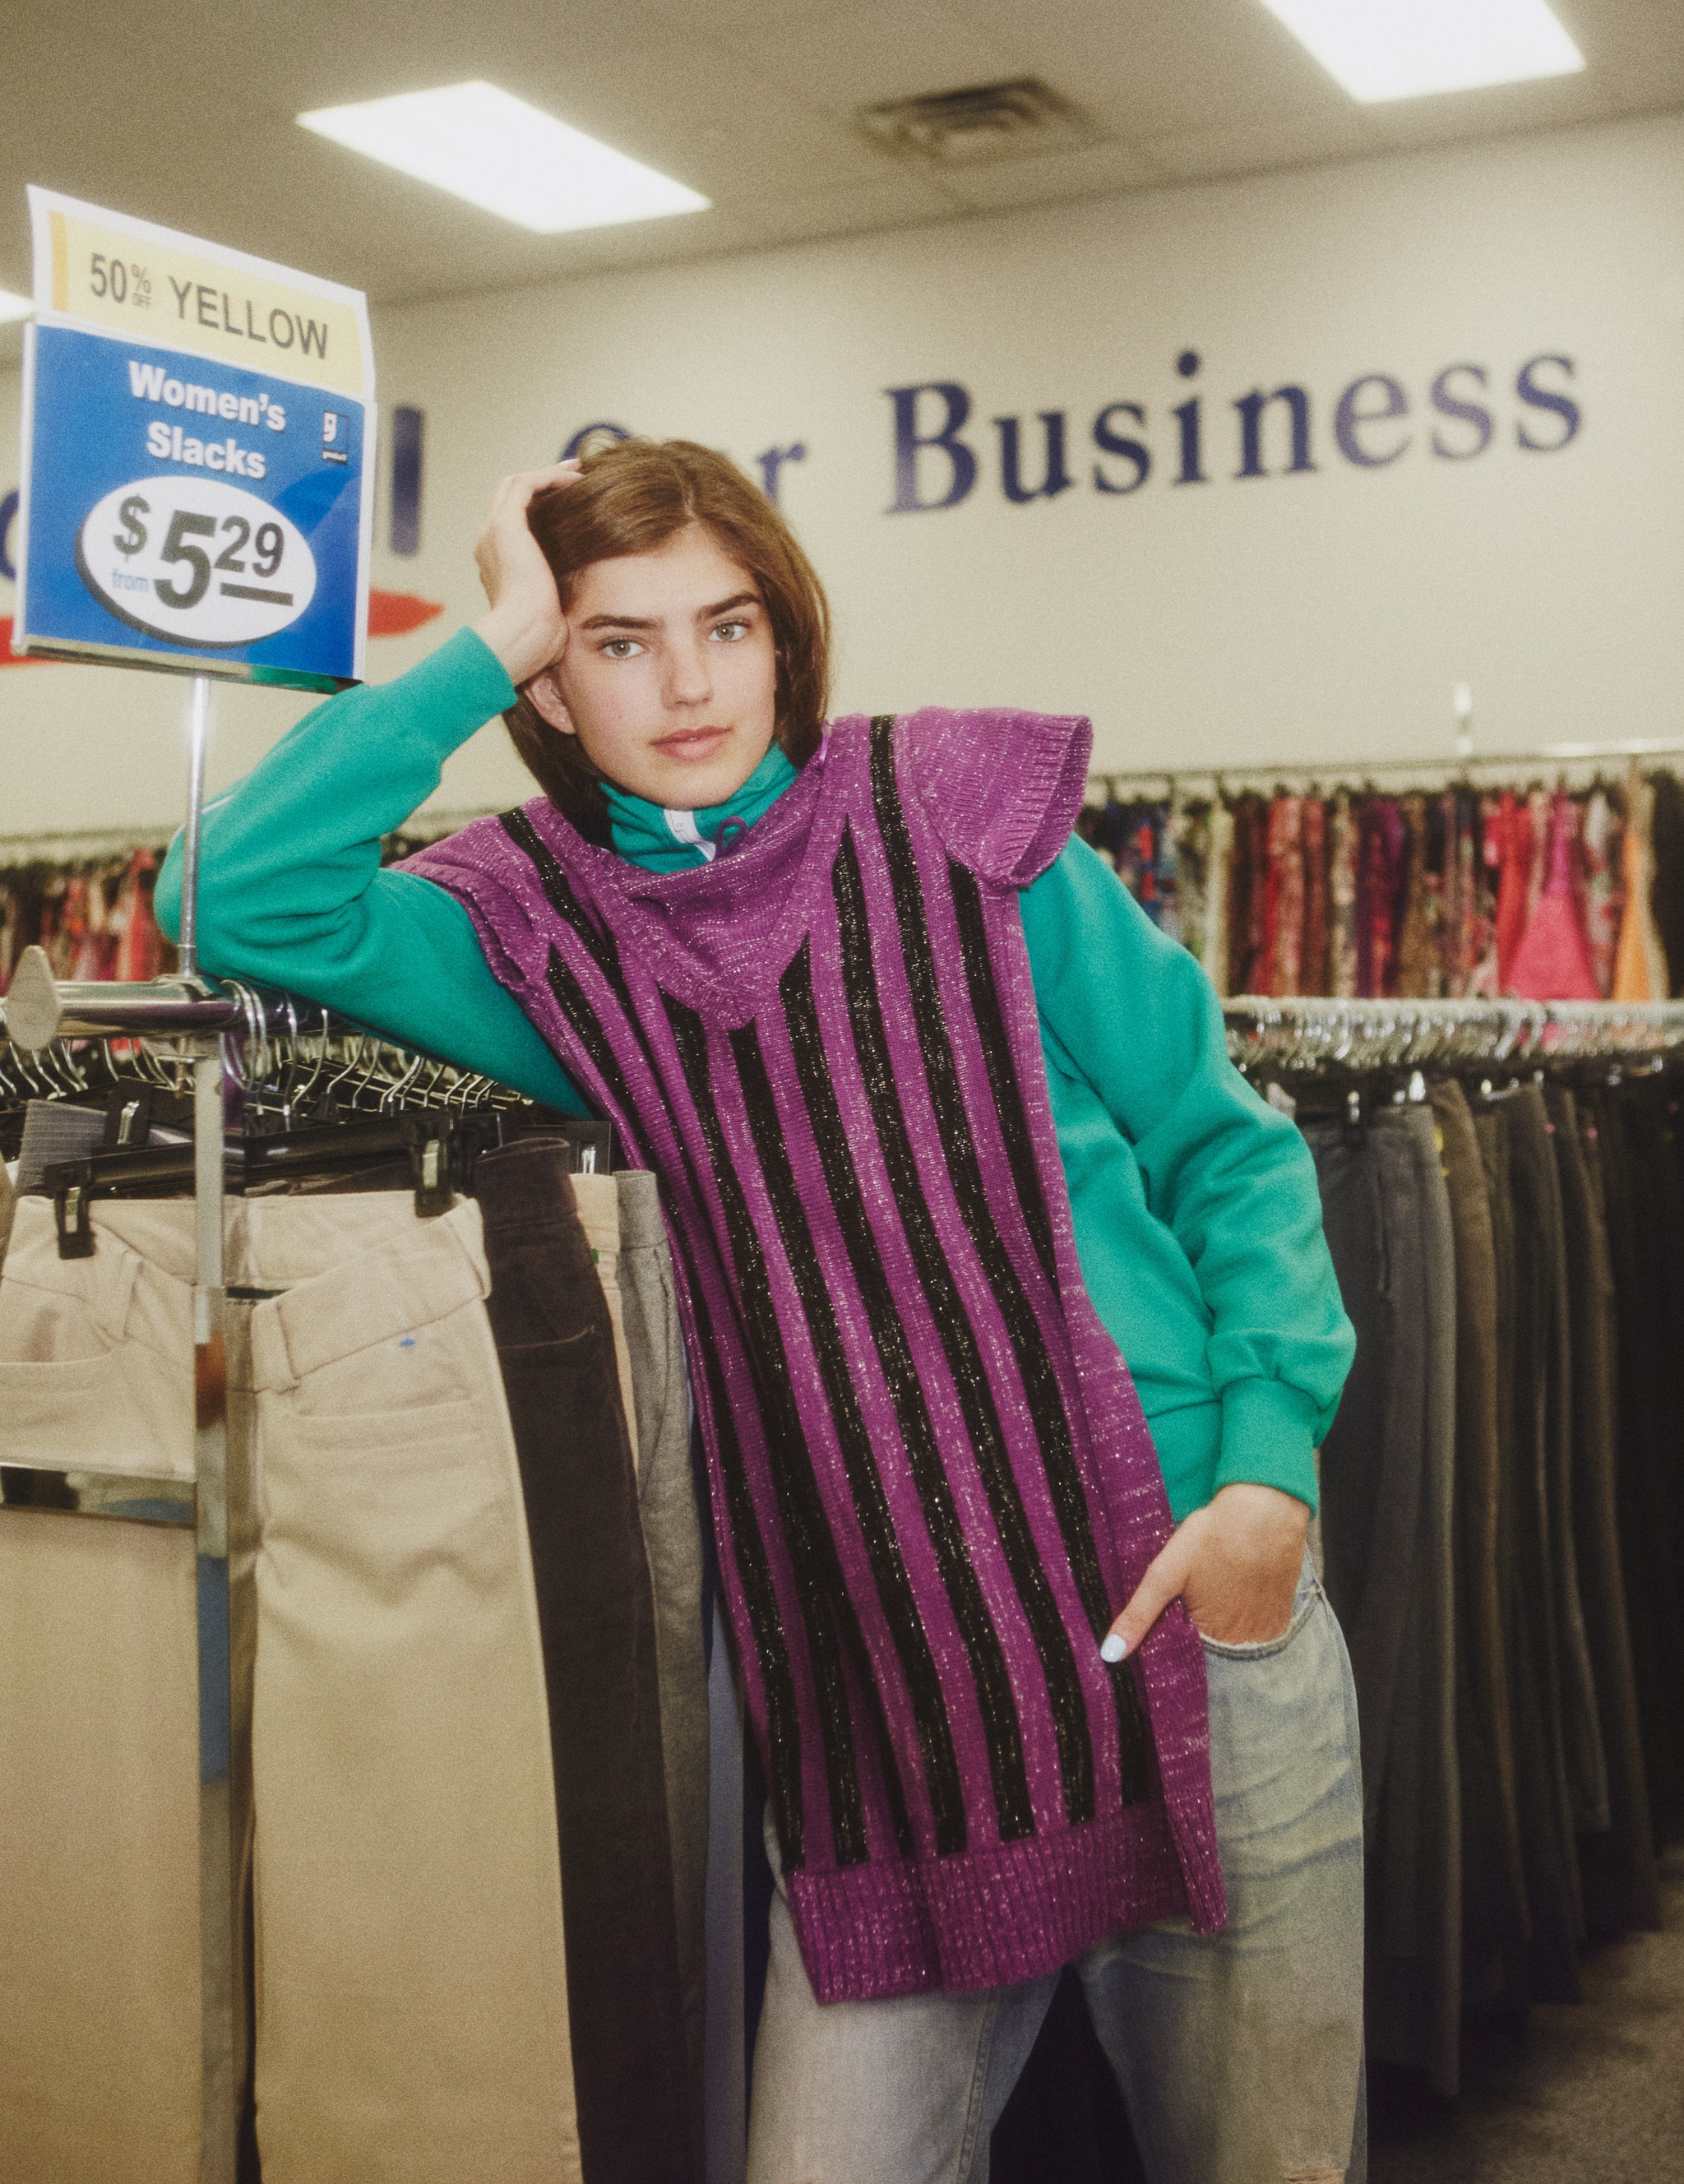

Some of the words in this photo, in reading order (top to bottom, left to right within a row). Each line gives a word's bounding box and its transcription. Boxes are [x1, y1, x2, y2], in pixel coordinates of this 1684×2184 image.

[167, 274, 329, 360] YELLOW
[128, 360, 286, 433] Women's
[881, 349, 1583, 515] Business
[146, 420, 266, 480] Slacks
[112, 567, 149, 593] from
